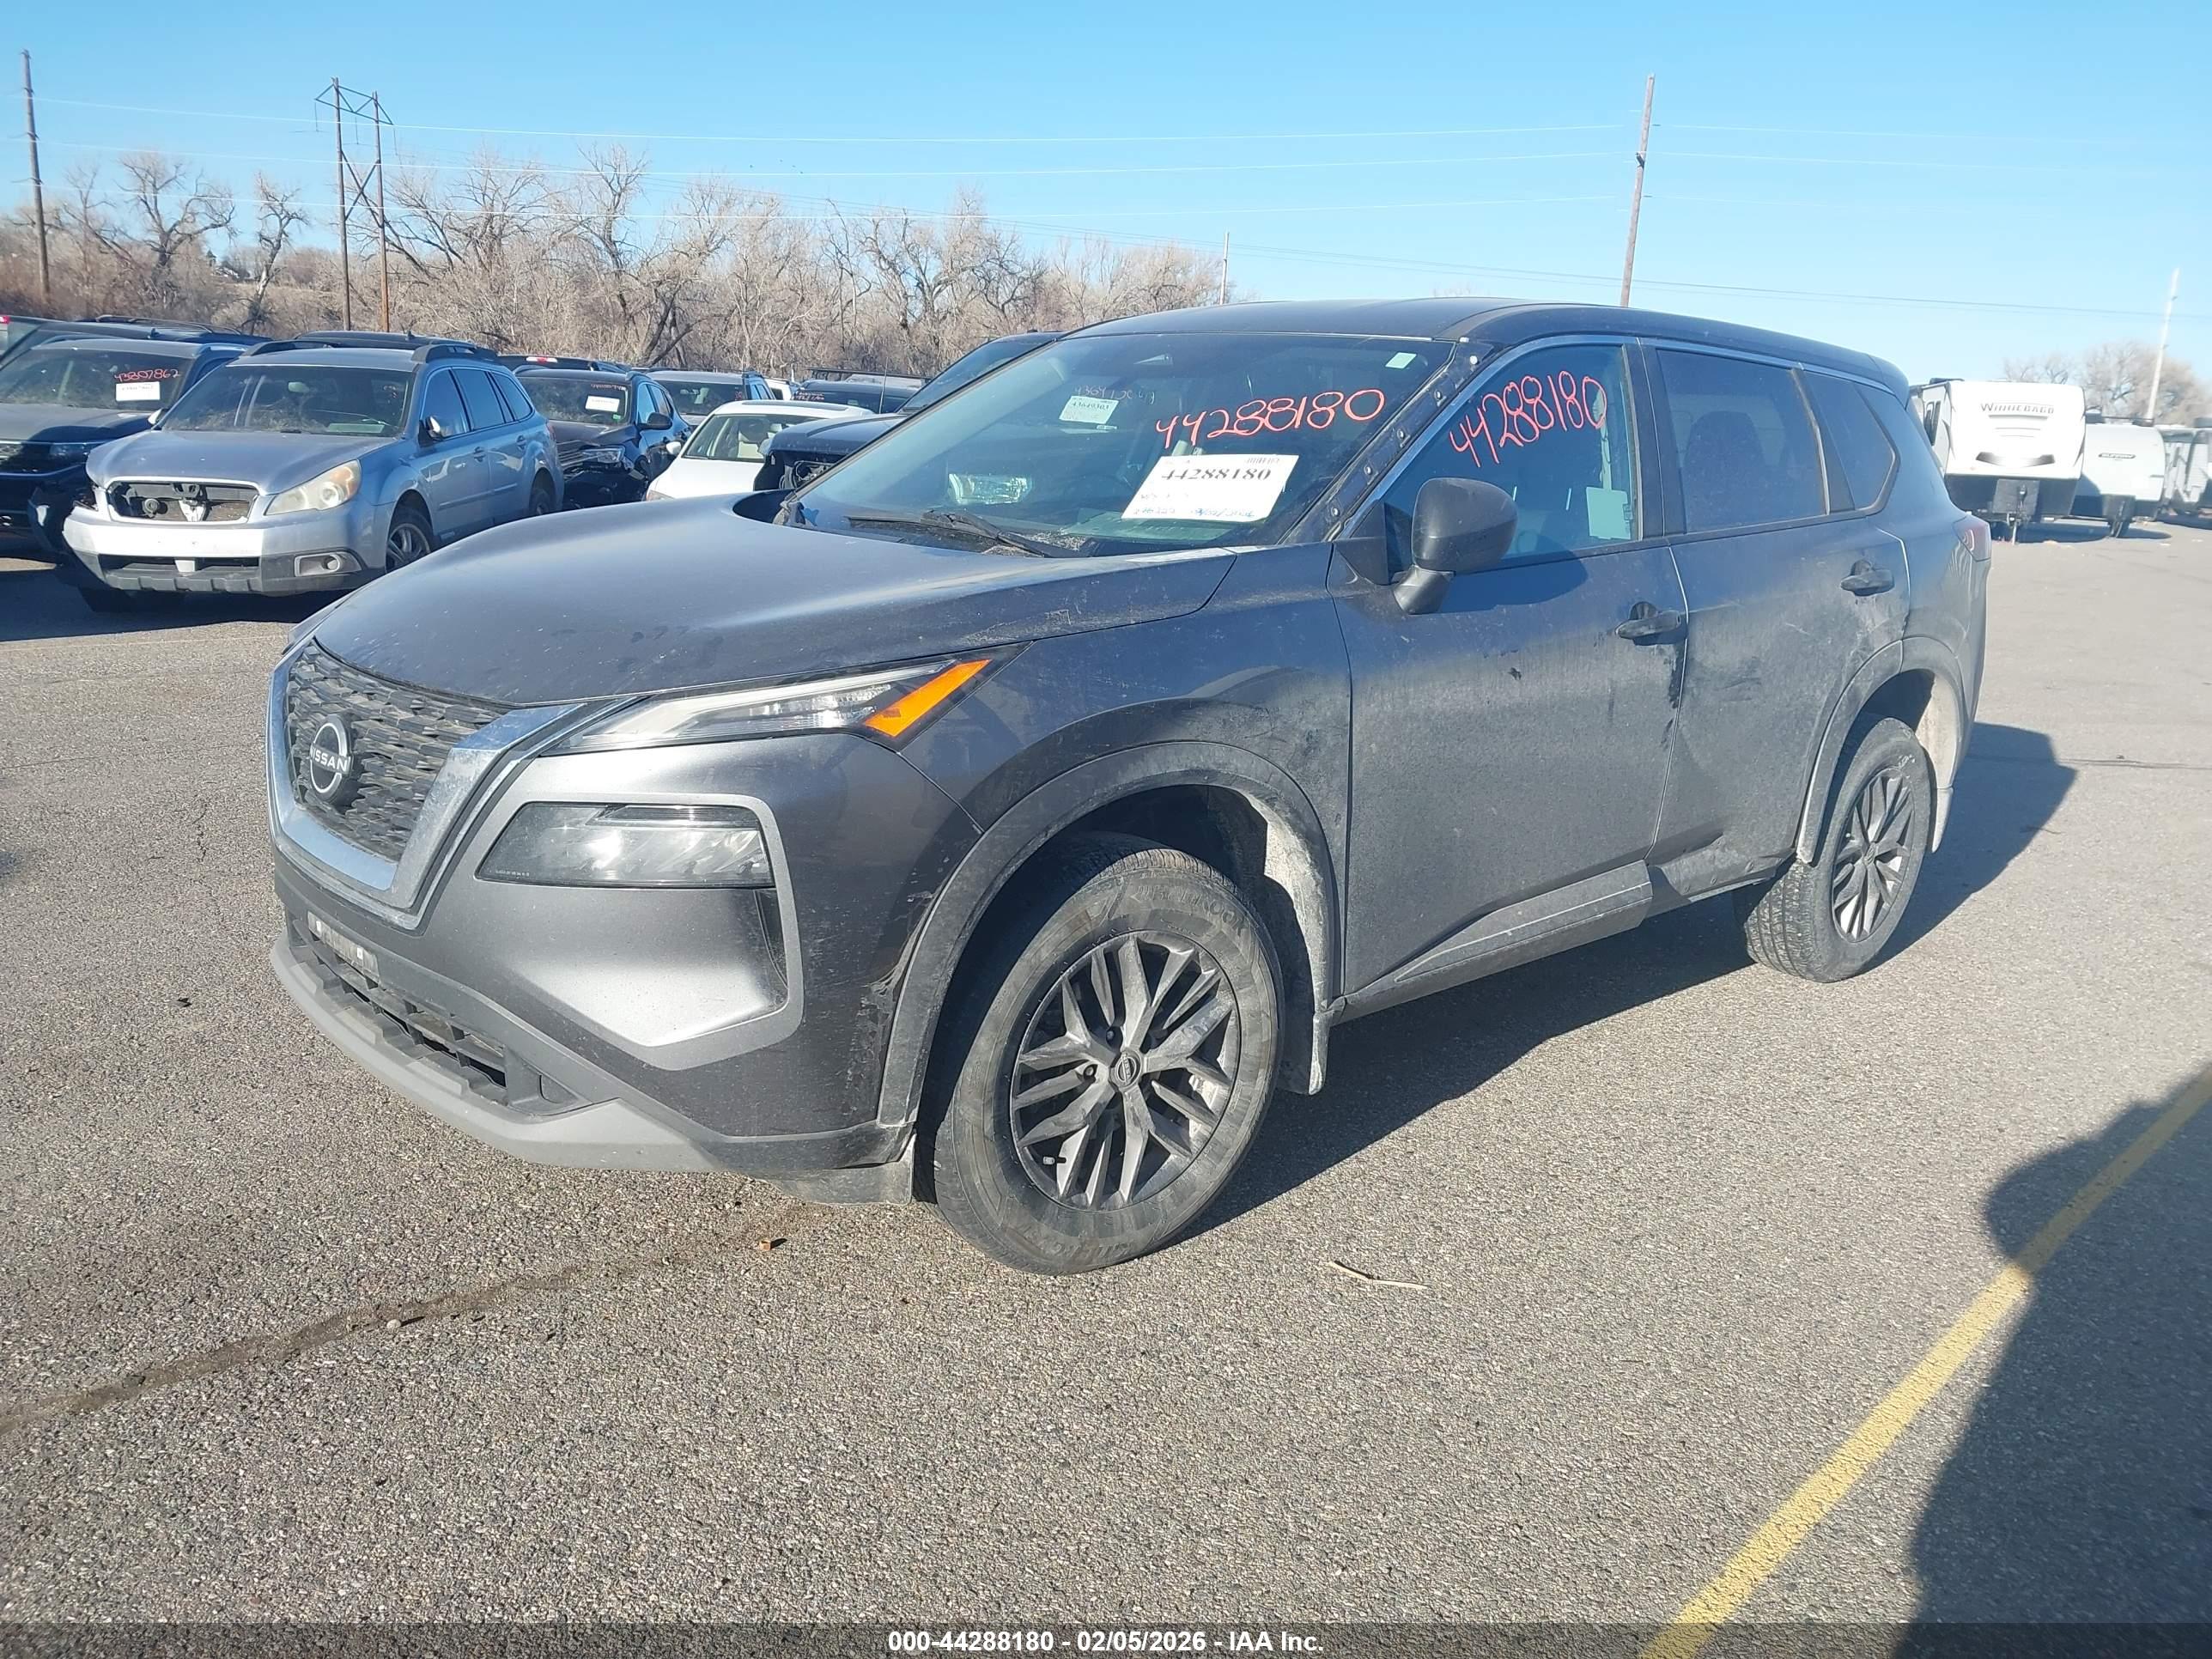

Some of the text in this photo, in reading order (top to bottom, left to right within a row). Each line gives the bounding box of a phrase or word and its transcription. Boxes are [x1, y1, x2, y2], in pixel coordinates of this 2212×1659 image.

[114, 368, 181, 382] 43807862
[1156, 389, 1385, 449] 44288180
[1449, 370, 1607, 468] 44288180
[1161, 468, 1272, 481] 44288180
